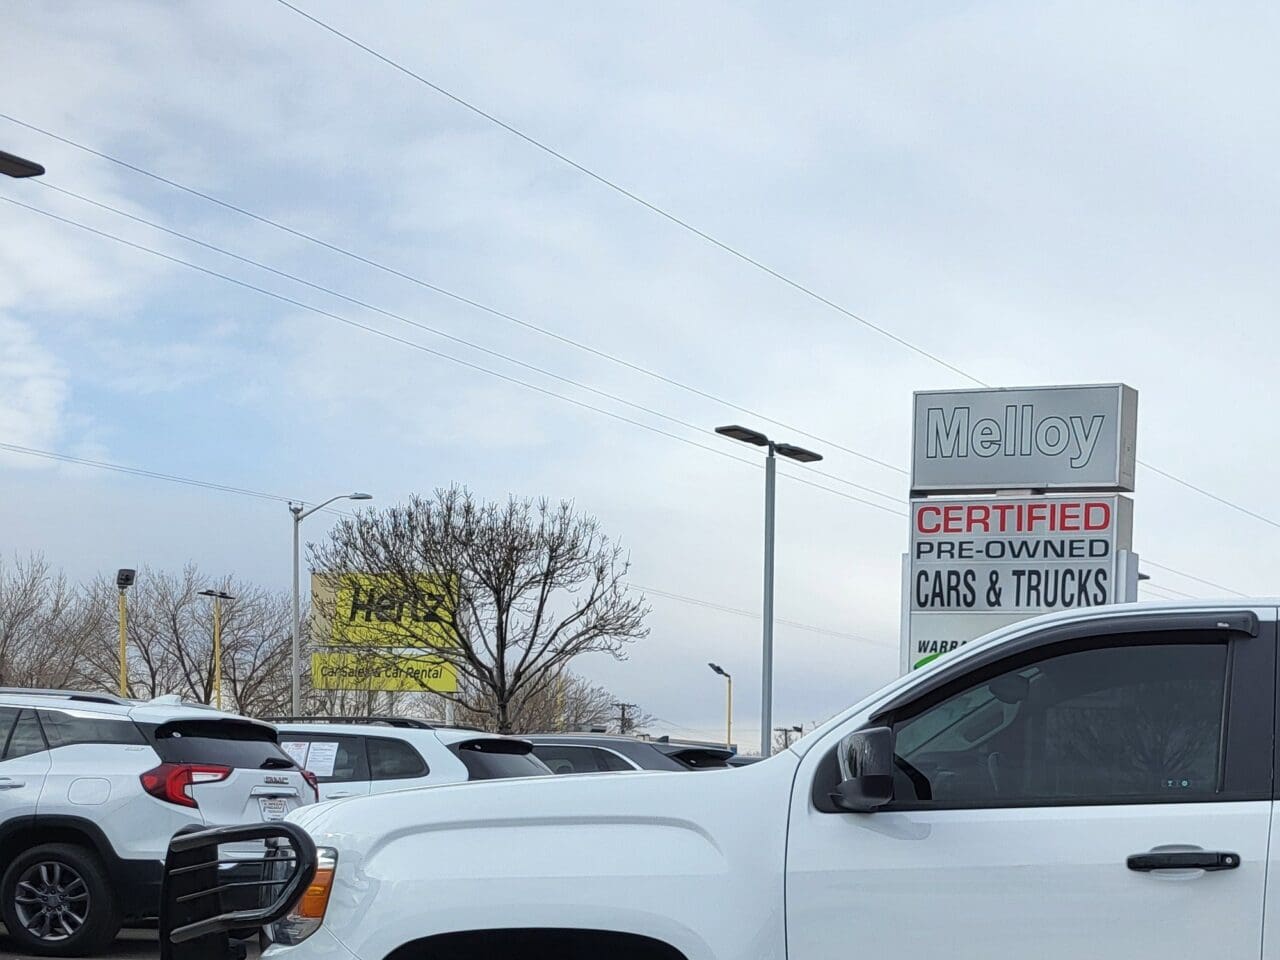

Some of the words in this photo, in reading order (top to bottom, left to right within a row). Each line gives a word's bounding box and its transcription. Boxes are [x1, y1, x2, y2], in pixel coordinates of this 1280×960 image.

[926, 404, 1106, 469] Melloy
[916, 502, 1111, 534] CERTIFIED
[915, 539, 1110, 560] PRE-OWNED
[915, 569, 977, 608] CARS
[986, 570, 1002, 607] &
[1012, 568, 1108, 607] TRUCKS
[321, 665, 339, 678] Car
[385, 666, 402, 679] Car
[406, 667, 443, 679] Rental
